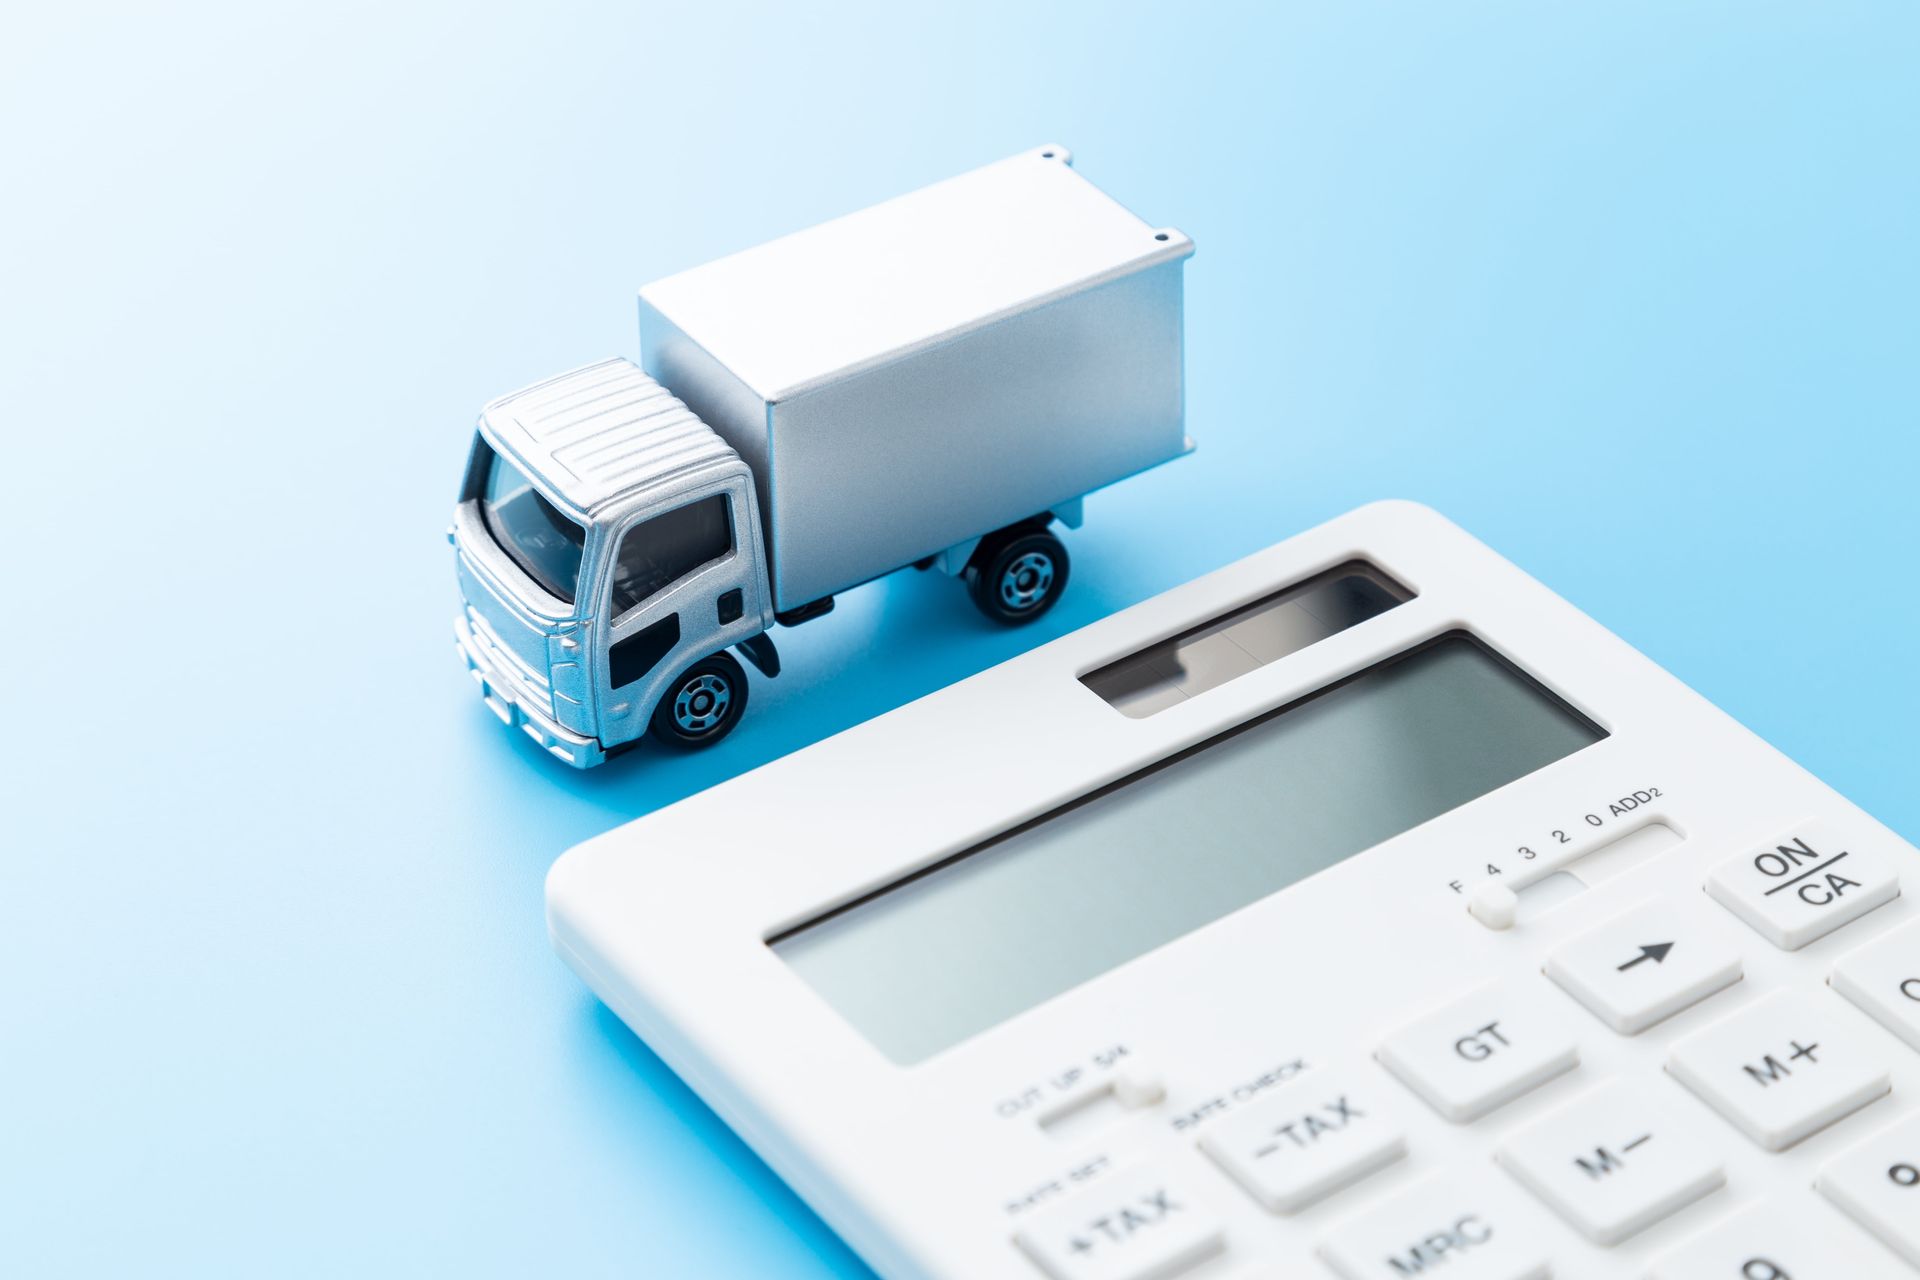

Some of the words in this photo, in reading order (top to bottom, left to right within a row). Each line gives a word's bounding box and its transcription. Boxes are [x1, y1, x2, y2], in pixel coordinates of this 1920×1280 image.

[1448, 880, 1464, 894] F
[1487, 863, 1502, 877] 4
[1517, 847, 1535, 860] 3
[1552, 829, 1571, 844] 2
[1754, 838, 1818, 877] ON
[1797, 873, 1861, 906] CA
[1455, 1022, 1510, 1061] GT
[1743, 1041, 1818, 1086] M+
[1171, 1098, 1228, 1131] RATE
[1232, 1058, 1311, 1099] CHECK
[1387, 1214, 1494, 1278] MRC
